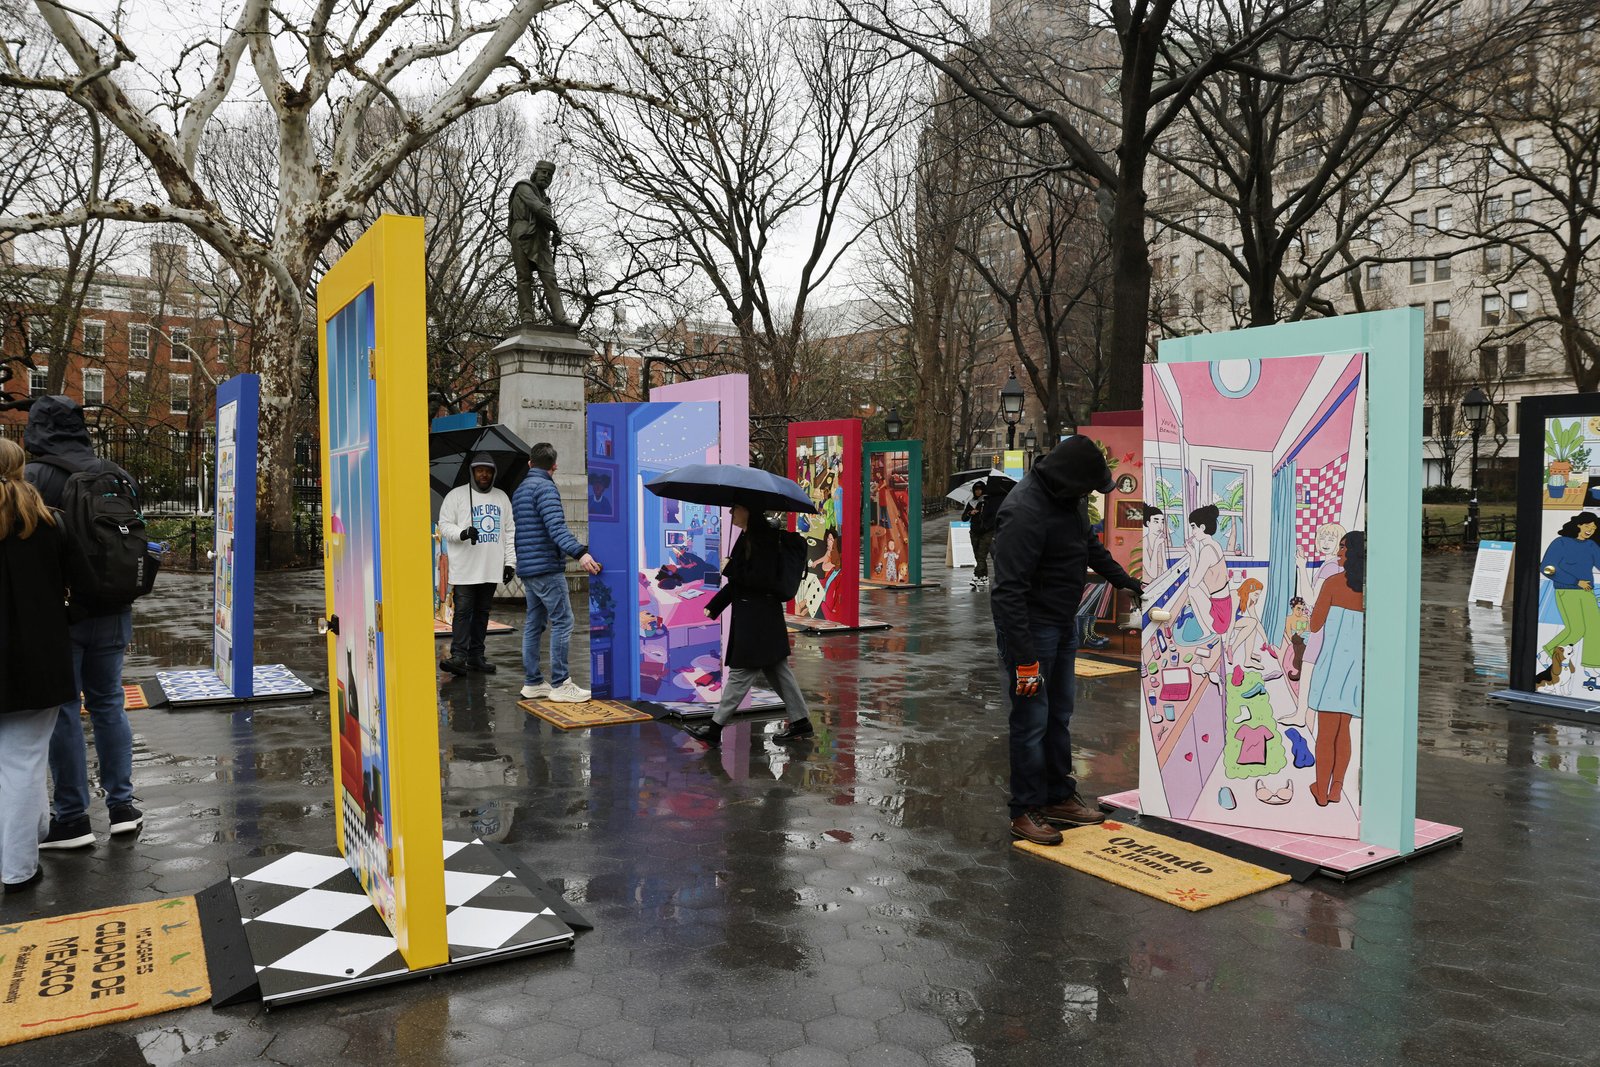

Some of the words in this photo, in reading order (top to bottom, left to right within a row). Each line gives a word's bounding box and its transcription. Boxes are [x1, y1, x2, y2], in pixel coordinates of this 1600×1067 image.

[521, 398, 582, 411] GARIBALDI
[472, 505, 484, 517] WE
[485, 504, 501, 516] OPEN
[1101, 846, 1122, 855] is
[1120, 852, 1178, 875] Home
[1108, 837, 1213, 874] Orlando
[93, 921, 126, 973] CIUDAD
[15, 952, 31, 970] Habitat
[38, 935, 89, 997] MÉXICO
[137, 963, 153, 975] ES
[2, 977, 25, 1004] Humanity
[90, 974, 126, 1000] DE
